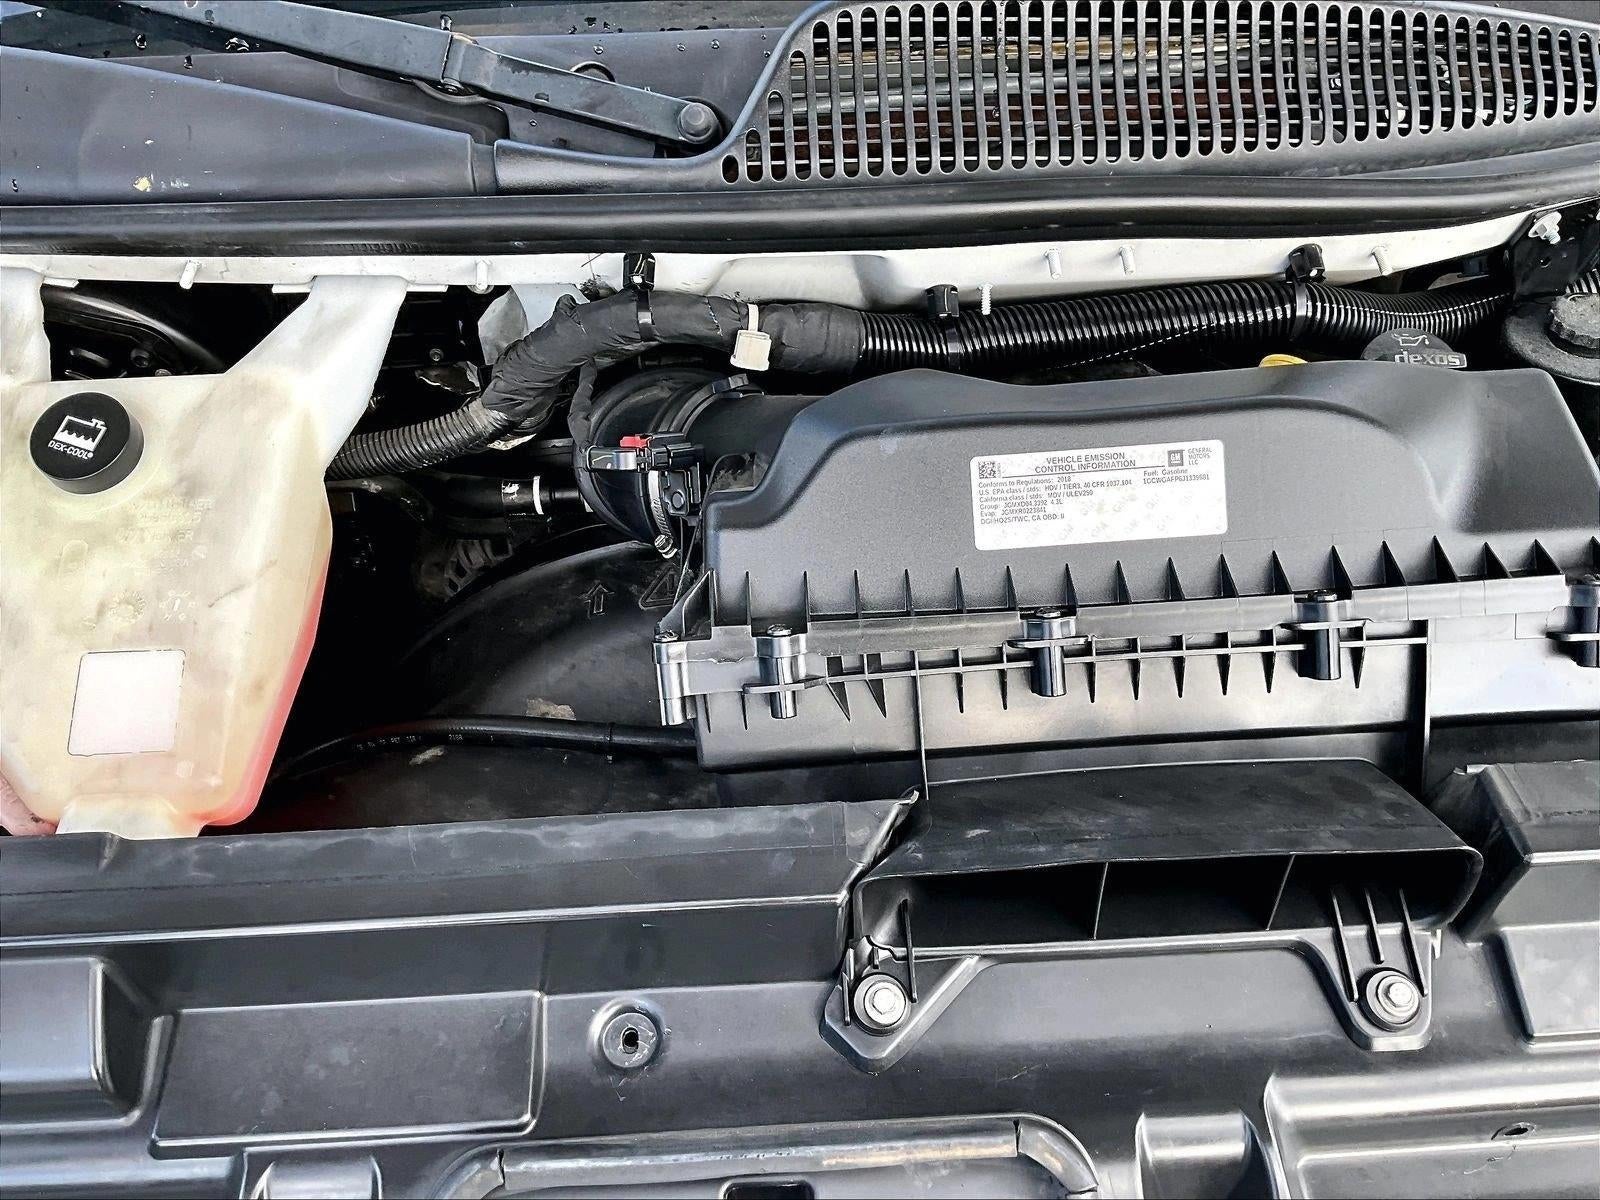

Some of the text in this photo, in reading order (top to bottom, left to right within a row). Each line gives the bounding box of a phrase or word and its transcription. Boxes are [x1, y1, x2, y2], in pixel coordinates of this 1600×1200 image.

[1394, 350, 1462, 366] dexos
[1046, 452, 1125, 465] VEHICLE EMISSION
[1034, 460, 1136, 474] CONTROL INFORMATION
[1161, 468, 1188, 476] Gasoline
[978, 480, 1008, 489] Conforms
[1016, 477, 1054, 487] Regulations:
[1005, 486, 1021, 494] class
[1091, 480, 1105, 488] CFR
[979, 495, 1008, 503] California
[979, 503, 1001, 511] Group:
[980, 510, 997, 518] Evap:
[1042, 513, 1059, 521] OBD:
